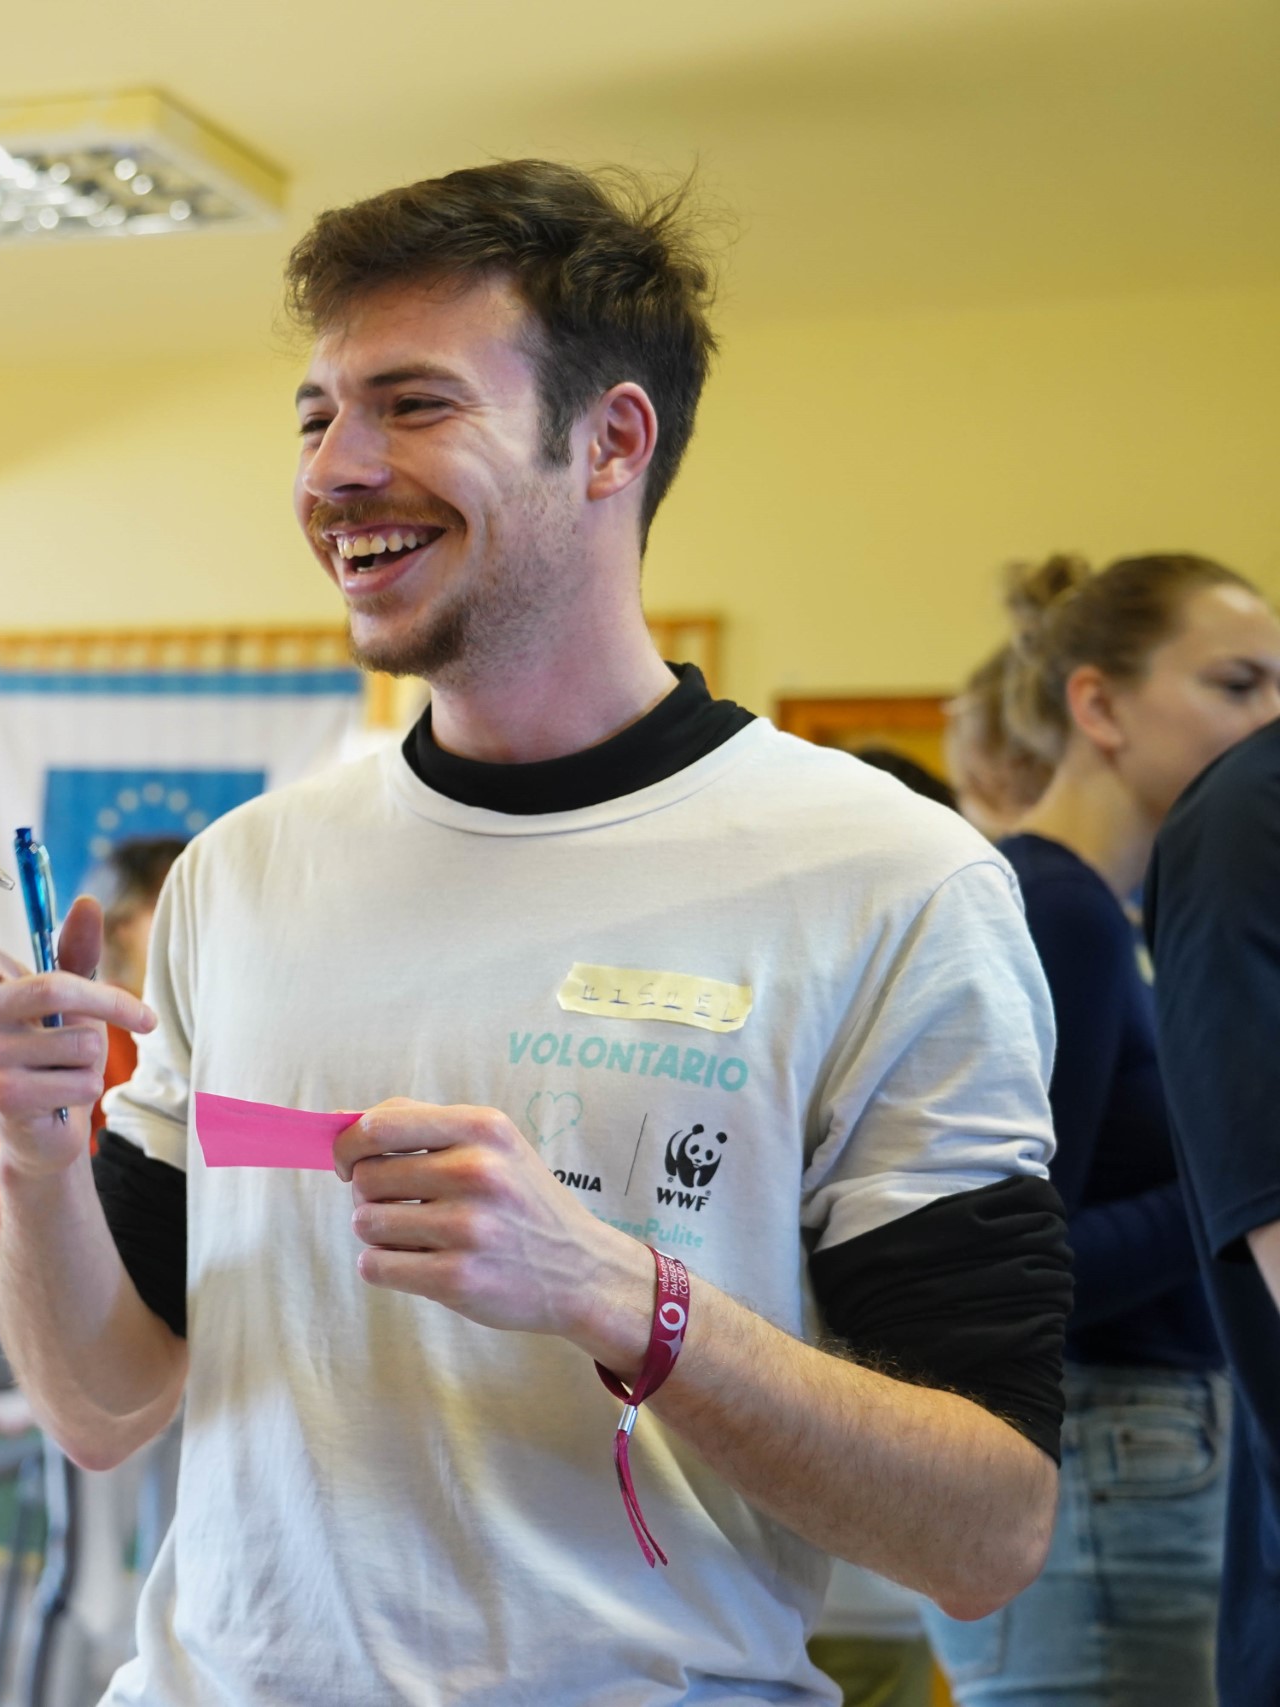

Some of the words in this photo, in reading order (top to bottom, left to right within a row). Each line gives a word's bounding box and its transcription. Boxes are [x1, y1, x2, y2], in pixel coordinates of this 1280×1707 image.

[508, 1032, 749, 1093] VOLONTARIO
[549, 1168, 602, 1193] ONIA
[656, 1187, 710, 1212] WWF
